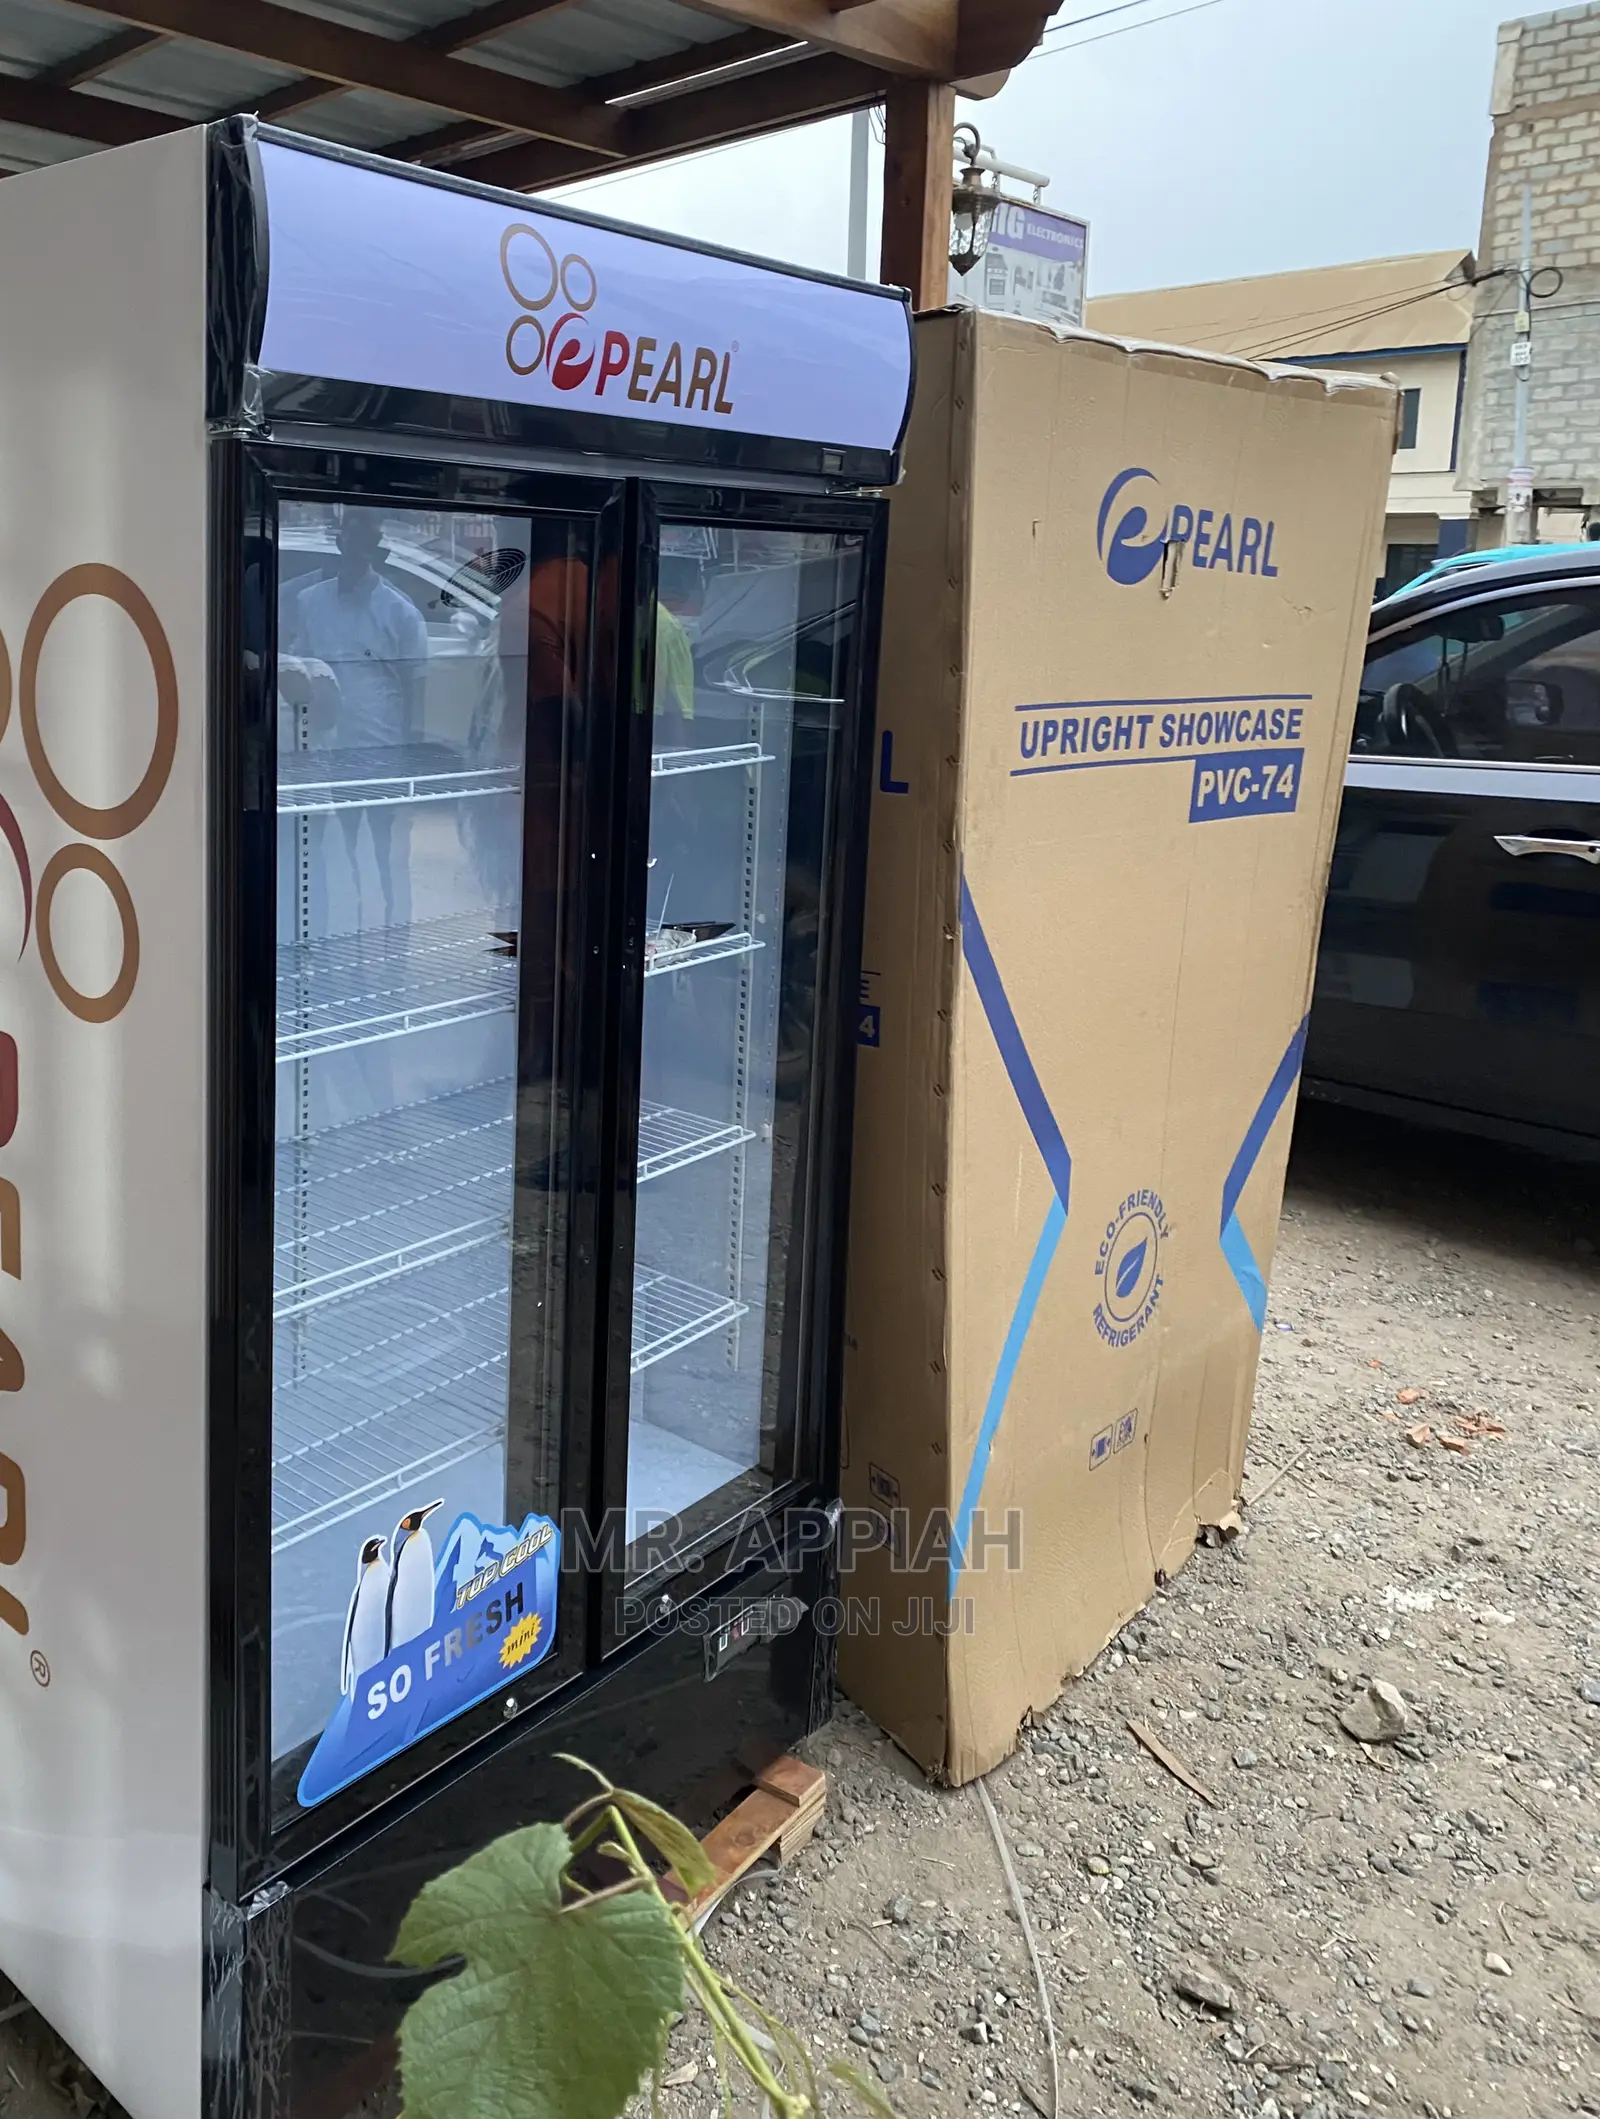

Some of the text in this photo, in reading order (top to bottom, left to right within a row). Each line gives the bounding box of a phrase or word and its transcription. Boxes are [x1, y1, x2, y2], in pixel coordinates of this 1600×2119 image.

[991, 202, 1025, 239] IG
[595, 330, 735, 414] PEARL
[1020, 708, 1304, 760] UPRIGHT SHOWCASE
[1196, 763, 1295, 807] PVC-74
[1094, 1188, 1169, 1276] ECO-FRIENDLY
[1092, 1273, 1164, 1348] REFRIGERANT
[456, 1521, 554, 1610] TOP COOL
[367, 1583, 524, 1721] SO FRESH
[507, 1621, 537, 1656] mini
